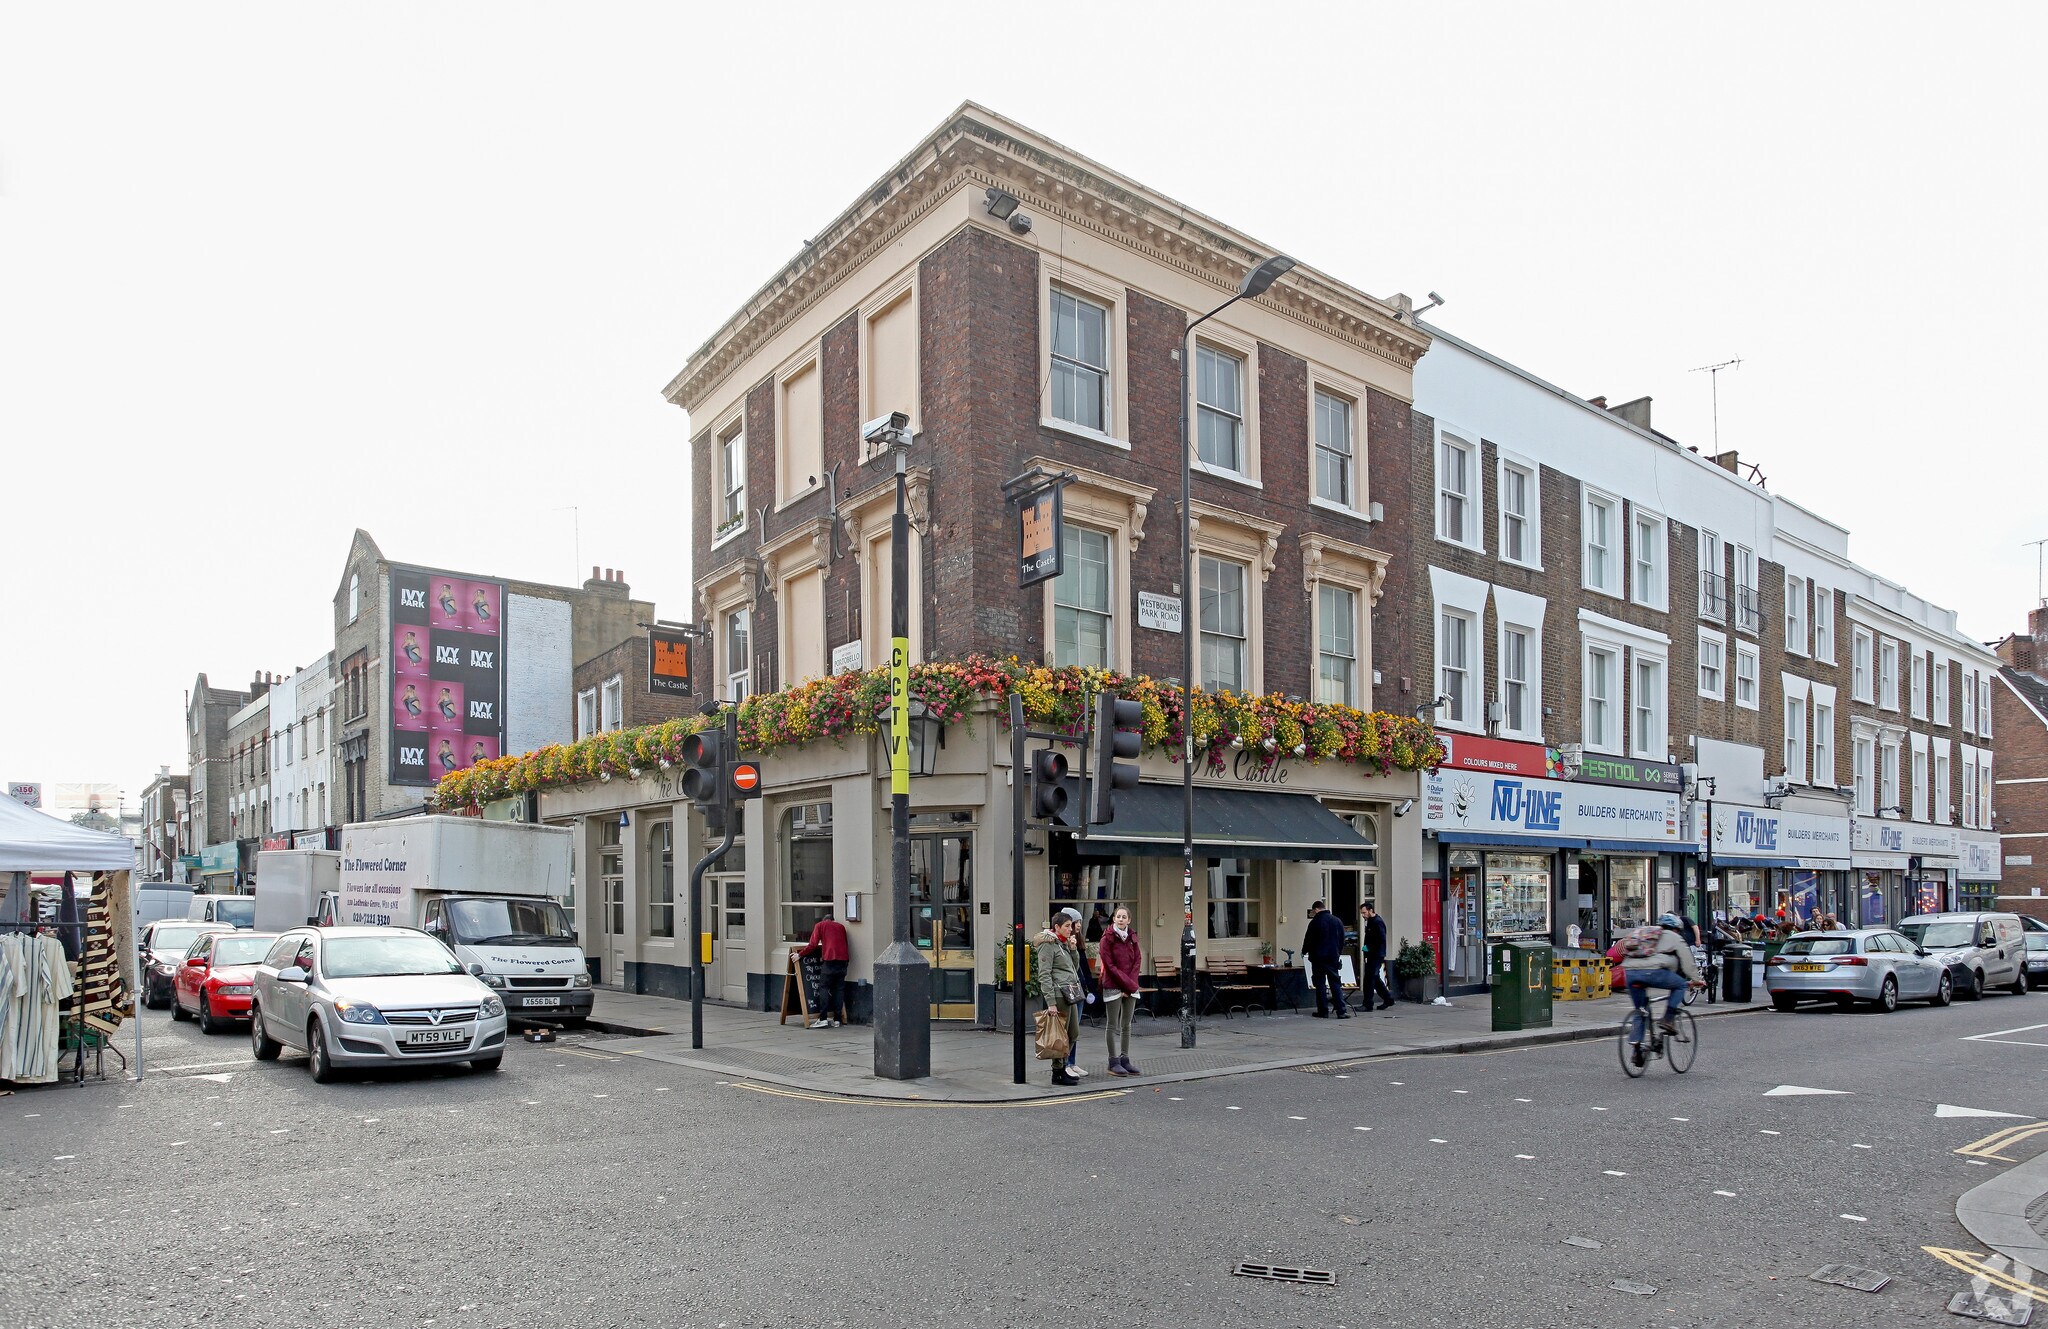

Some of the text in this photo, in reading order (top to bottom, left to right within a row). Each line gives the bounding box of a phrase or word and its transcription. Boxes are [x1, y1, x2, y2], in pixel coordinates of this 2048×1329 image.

[1022, 555, 1055, 573] The Castle
[401, 588, 425, 601] IVY
[401, 599, 425, 608] PARK
[1140, 598, 1181, 613] WESTBOURNE
[1142, 608, 1179, 622] PARK ROAD
[436, 646, 459, 658] IVY
[471, 650, 493, 662] IVY
[436, 656, 459, 665] PARK
[471, 660, 493, 669] PARK
[834, 653, 860, 667] PORTOBELLO
[653, 679, 688, 690] The Castle
[470, 701, 493, 713] IVY
[892, 648, 901, 755] CCTV
[470, 711, 492, 719] PARK
[400, 747, 424, 759] IVY
[400, 757, 424, 766] PARK
[1233, 750, 1289, 784] Castle
[1464, 757, 1518, 771] COLOURS MIXED HERE
[1580, 759, 1640, 782] FESTOOL
[1664, 772, 1679, 780] SERVICE
[650, 771, 672, 800] The
[1491, 780, 1562, 831] NU-LINE
[1578, 805, 1663, 822] BUILDERS MERCHANTS
[1736, 811, 1777, 850] NU-LINE
[1788, 829, 1839, 842] BUILDERS MERCHANTS
[1881, 827, 1902, 850] NU-LINE
[1912, 837, 1928, 846] BUILDERS
[1929, 838, 1948, 847] MERCHANTS
[344, 858, 407, 871] The Flowered Corner
[347, 883, 363, 892] Flowers
[378, 884, 401, 894] occasions
[411, 1031, 461, 1043] MT59 VLF
